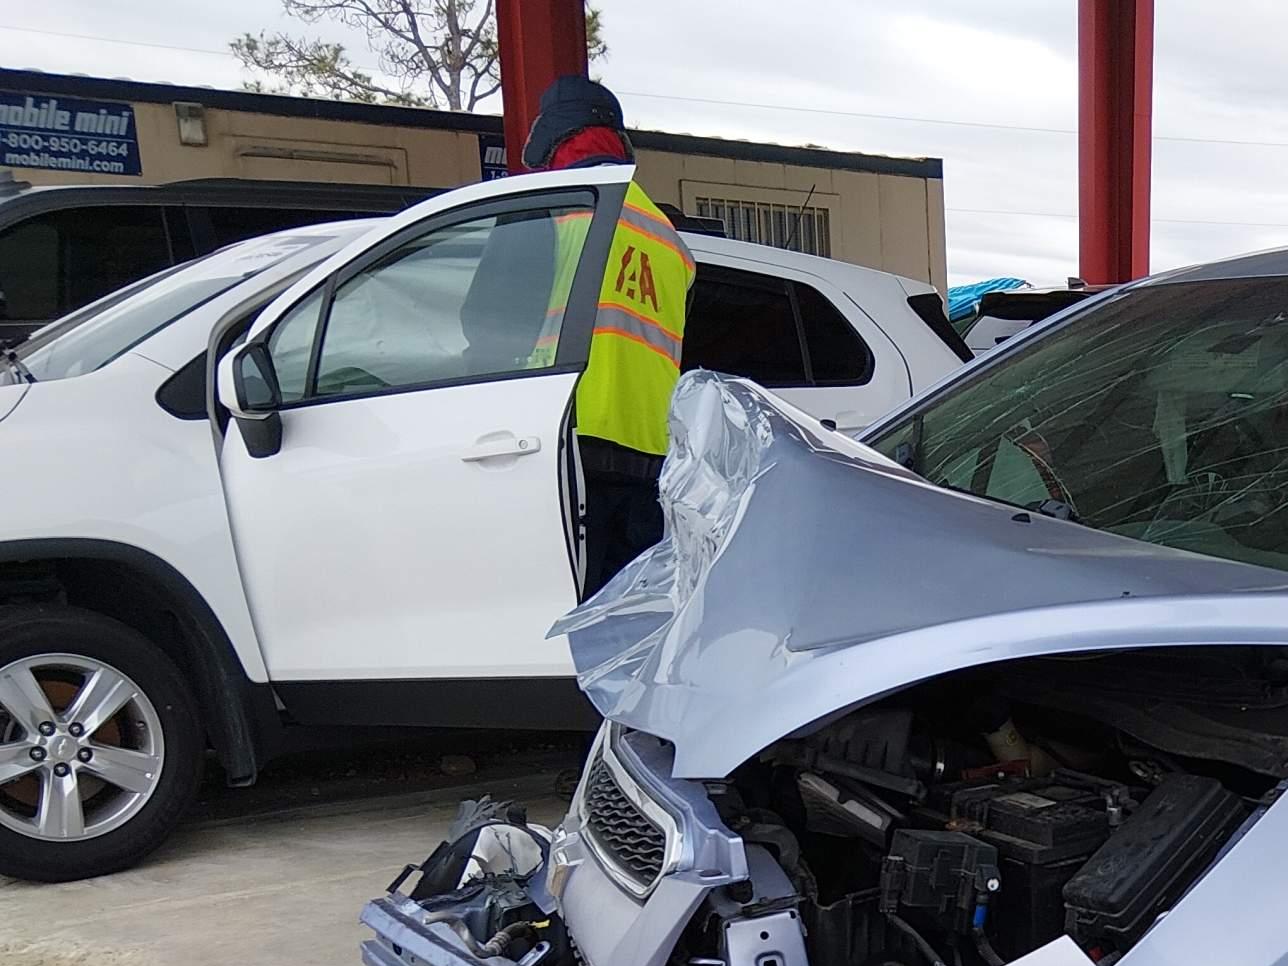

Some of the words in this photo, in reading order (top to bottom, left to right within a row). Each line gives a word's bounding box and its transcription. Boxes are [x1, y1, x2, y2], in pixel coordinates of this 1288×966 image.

[74, 109, 130, 136] mini
[0, 132, 128, 157] -800-950-6464
[5, 152, 124, 173] mobilemini.com
